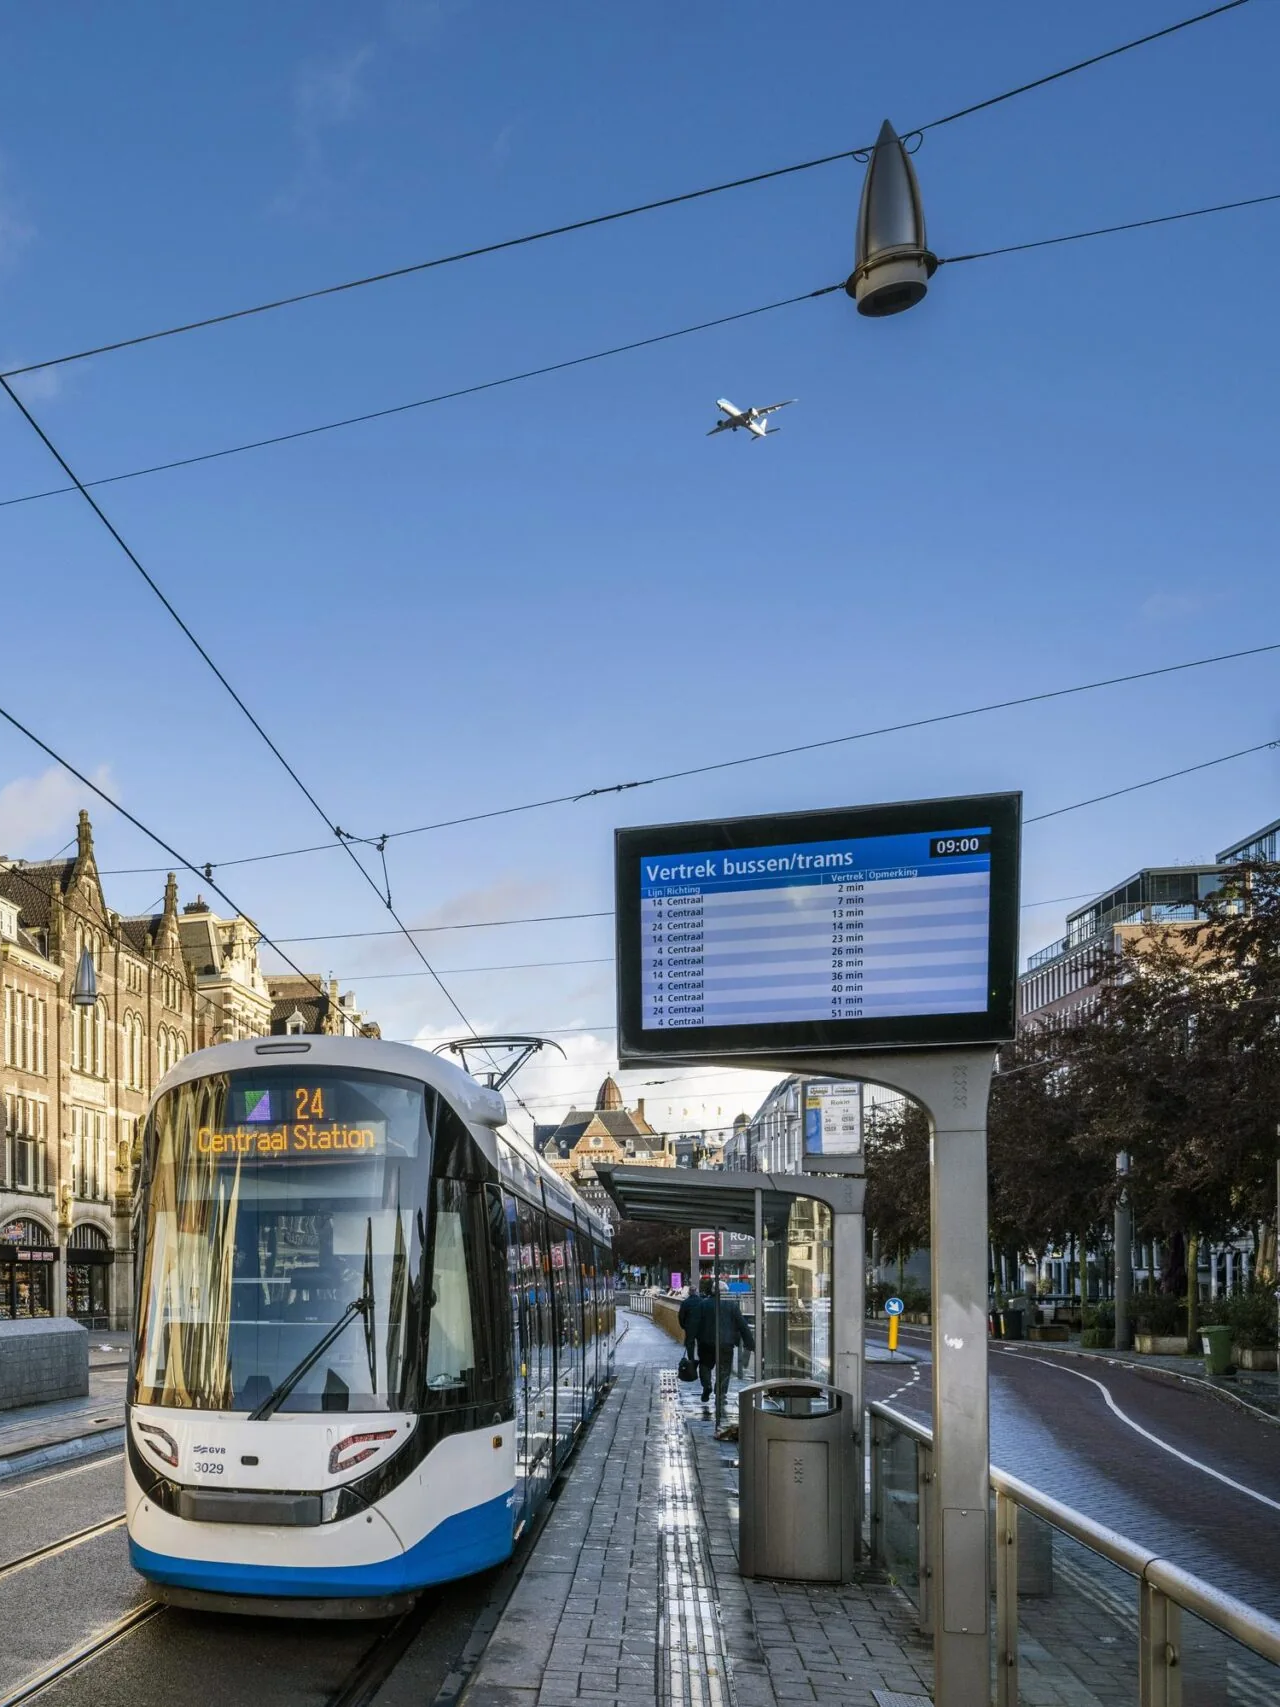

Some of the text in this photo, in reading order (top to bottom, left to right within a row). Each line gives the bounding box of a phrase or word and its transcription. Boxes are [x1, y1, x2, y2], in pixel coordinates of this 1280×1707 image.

[936, 838, 979, 854] 09:00
[646, 852, 853, 882] Vertrek bussen/trams
[647, 868, 918, 898] Lijn Richting Vertrek Opmerking
[653, 883, 864, 907] 14 Centraal 2 min
[667, 908, 704, 918] Centraal
[838, 896, 844, 905] 7
[846, 896, 864, 904] min
[652, 908, 864, 932] 24 Centraal 13 min
[653, 921, 864, 943] 14 Centraal 14 min
[658, 933, 864, 955] 4 Centraal 23 min
[653, 946, 864, 968] 24 Centraal 26 min
[653, 958, 864, 979] 14 Centraal 28 min
[667, 980, 704, 990] Centraal
[832, 972, 843, 980] 36
[846, 970, 864, 980] min
[667, 992, 704, 1002] Centraal
[832, 984, 843, 992] 40
[846, 984, 864, 992] min
[653, 996, 864, 1015] 24 Centraal 41 min
[667, 1016, 704, 1026] Centraal
[832, 1009, 842, 1018] 51
[846, 1008, 864, 1016] min
[295, 1087, 324, 1120] 24
[198, 1123, 375, 1153] Centraal Station
[194, 1462, 224, 1475] 3029
